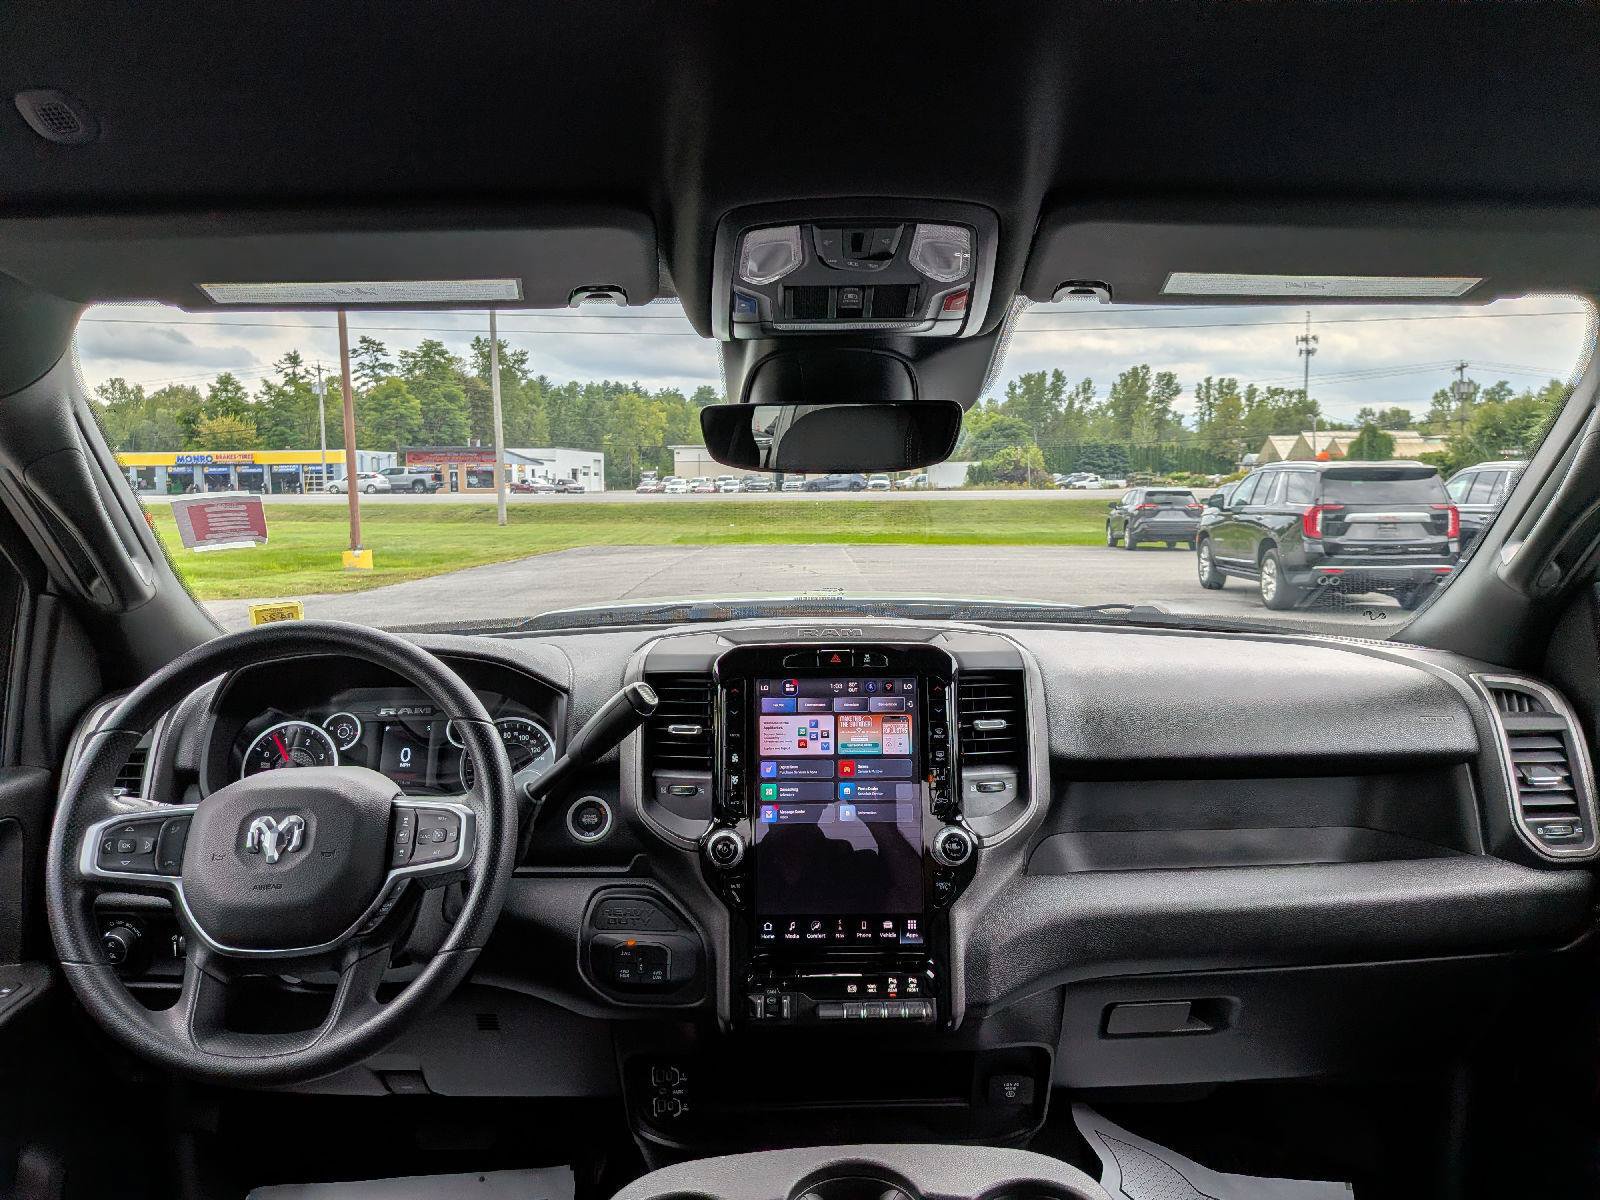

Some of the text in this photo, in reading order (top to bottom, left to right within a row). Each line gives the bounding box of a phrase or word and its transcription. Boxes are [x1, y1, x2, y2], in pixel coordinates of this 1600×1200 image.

[176, 455, 213, 464] MONRO
[798, 628, 862, 637] RAM
[377, 707, 432, 717] RAM
[401, 748, 411, 763] 0
[252, 883, 283, 891] AIRBAG
